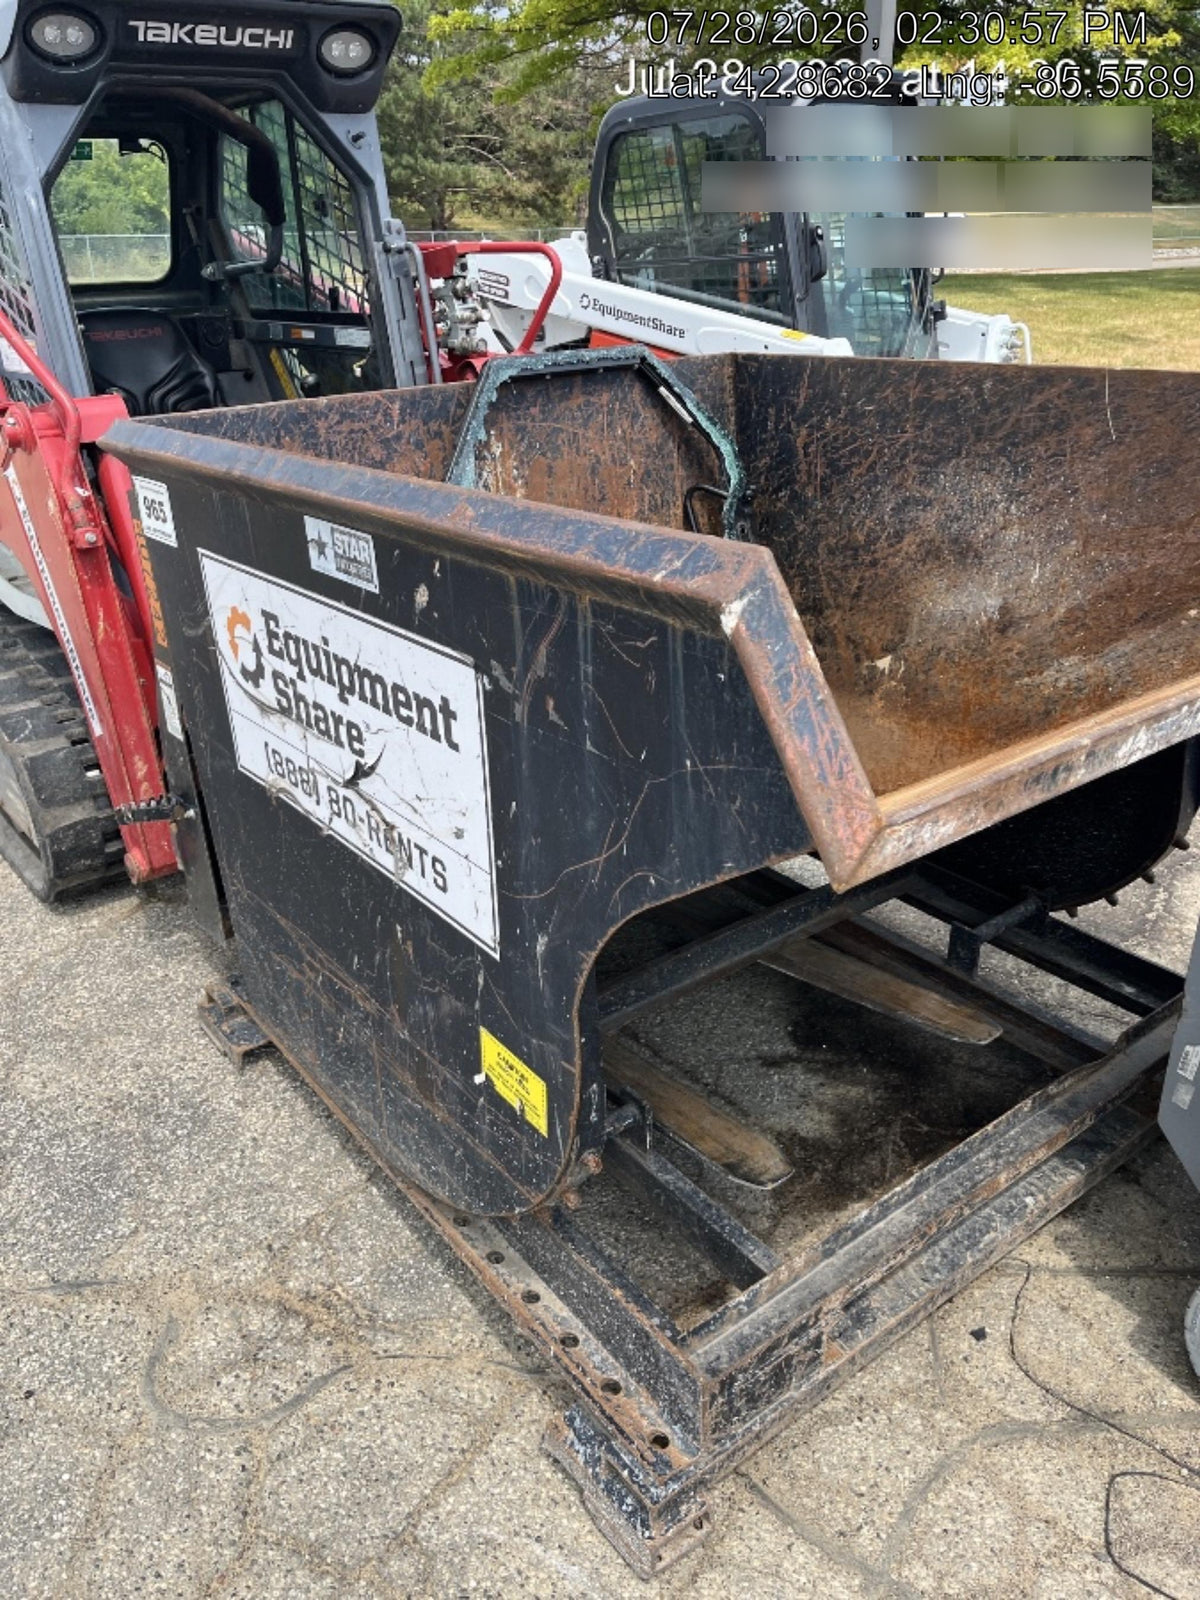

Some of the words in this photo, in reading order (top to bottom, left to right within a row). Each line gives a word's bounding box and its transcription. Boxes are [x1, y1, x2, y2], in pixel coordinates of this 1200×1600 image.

[591, 298, 686, 339] EquipmentShare
[143, 495, 168, 524] 965
[334, 532, 371, 565] STAR
[260, 607, 461, 753] Equipment
[271, 668, 366, 759] Share
[263, 740, 321, 807] (888)
[326, 784, 449, 894] 80-RENTS
